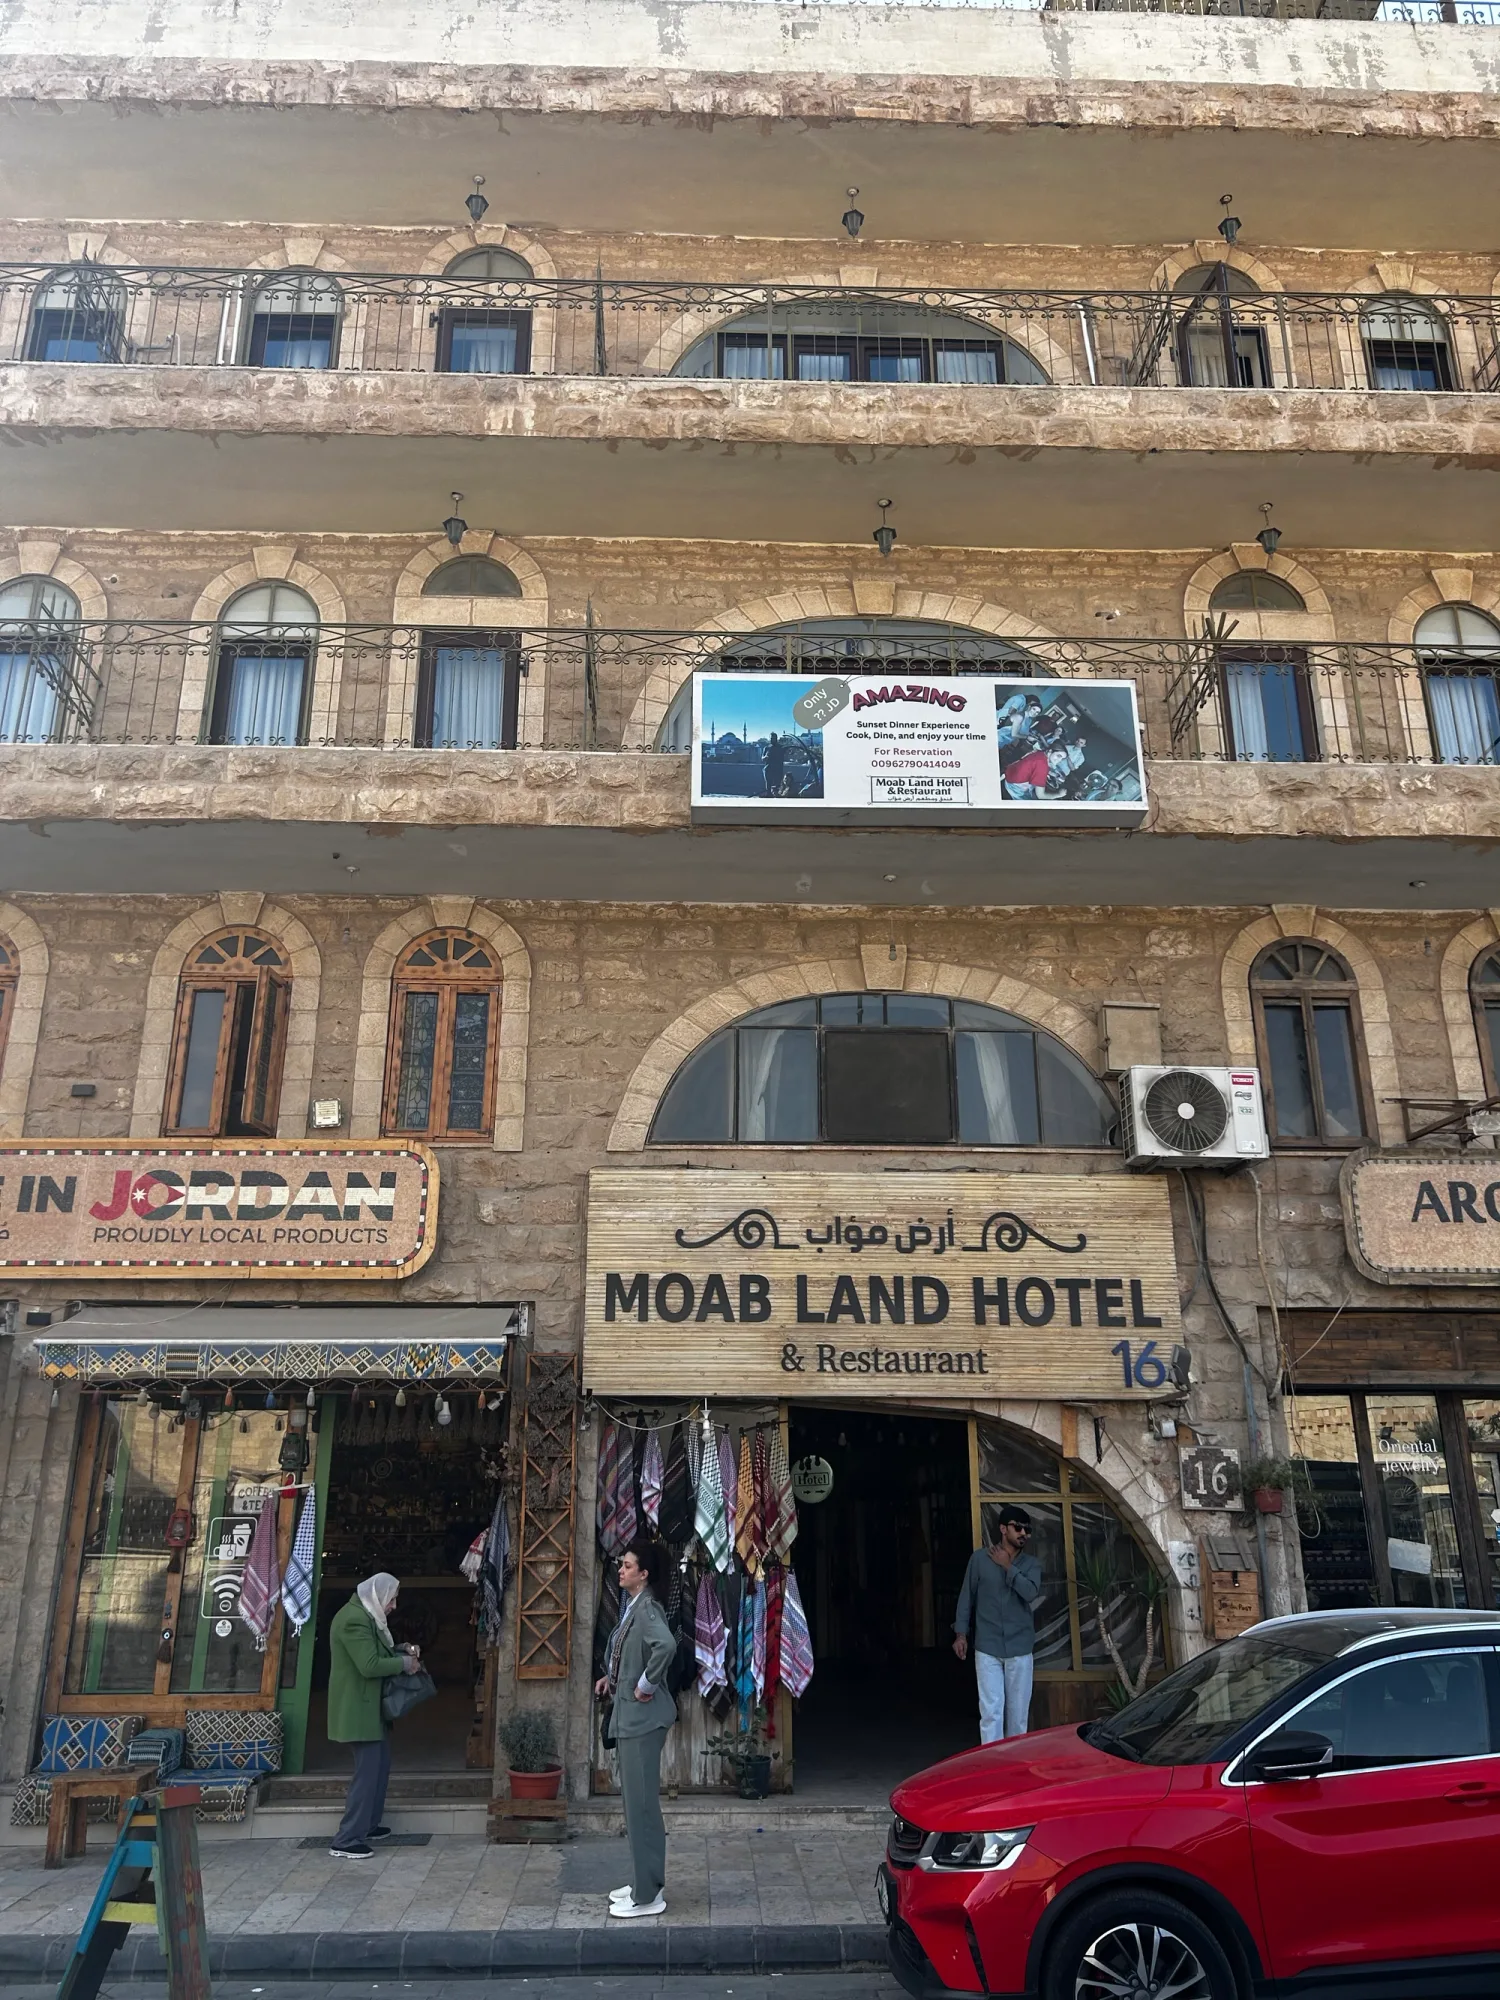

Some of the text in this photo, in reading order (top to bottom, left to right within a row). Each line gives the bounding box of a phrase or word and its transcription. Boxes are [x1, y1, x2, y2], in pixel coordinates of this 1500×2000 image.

[803, 688, 828, 710] Only
[827, 698, 840, 713] JD
[853, 684, 968, 713] AMAZING
[856, 720, 970, 730] Sunset Dinner Experience
[846, 731, 986, 741] Cook, Dine, and enjoy your time
[874, 748, 953, 756] For Reservation
[871, 760, 961, 768] 00962790414049
[876, 778, 963, 787] Moab Land Hotel
[17, 1175, 77, 1213] IN
[89, 1169, 397, 1222] JORDAN
[93, 1227, 388, 1244] PROUDLY LOCAL PRODUCTS
[806, 1208, 955, 1254] أرض مؤاب
[604, 1273, 1162, 1329] MOAB LAND HOTEL
[780, 1343, 989, 1375] & Restaurant
[1111, 1340, 1166, 1388] 16
[1378, 1438, 1438, 1453] Oriental
[798, 1474, 826, 1485] Hotel
[1194, 1461, 1228, 1495] 16
